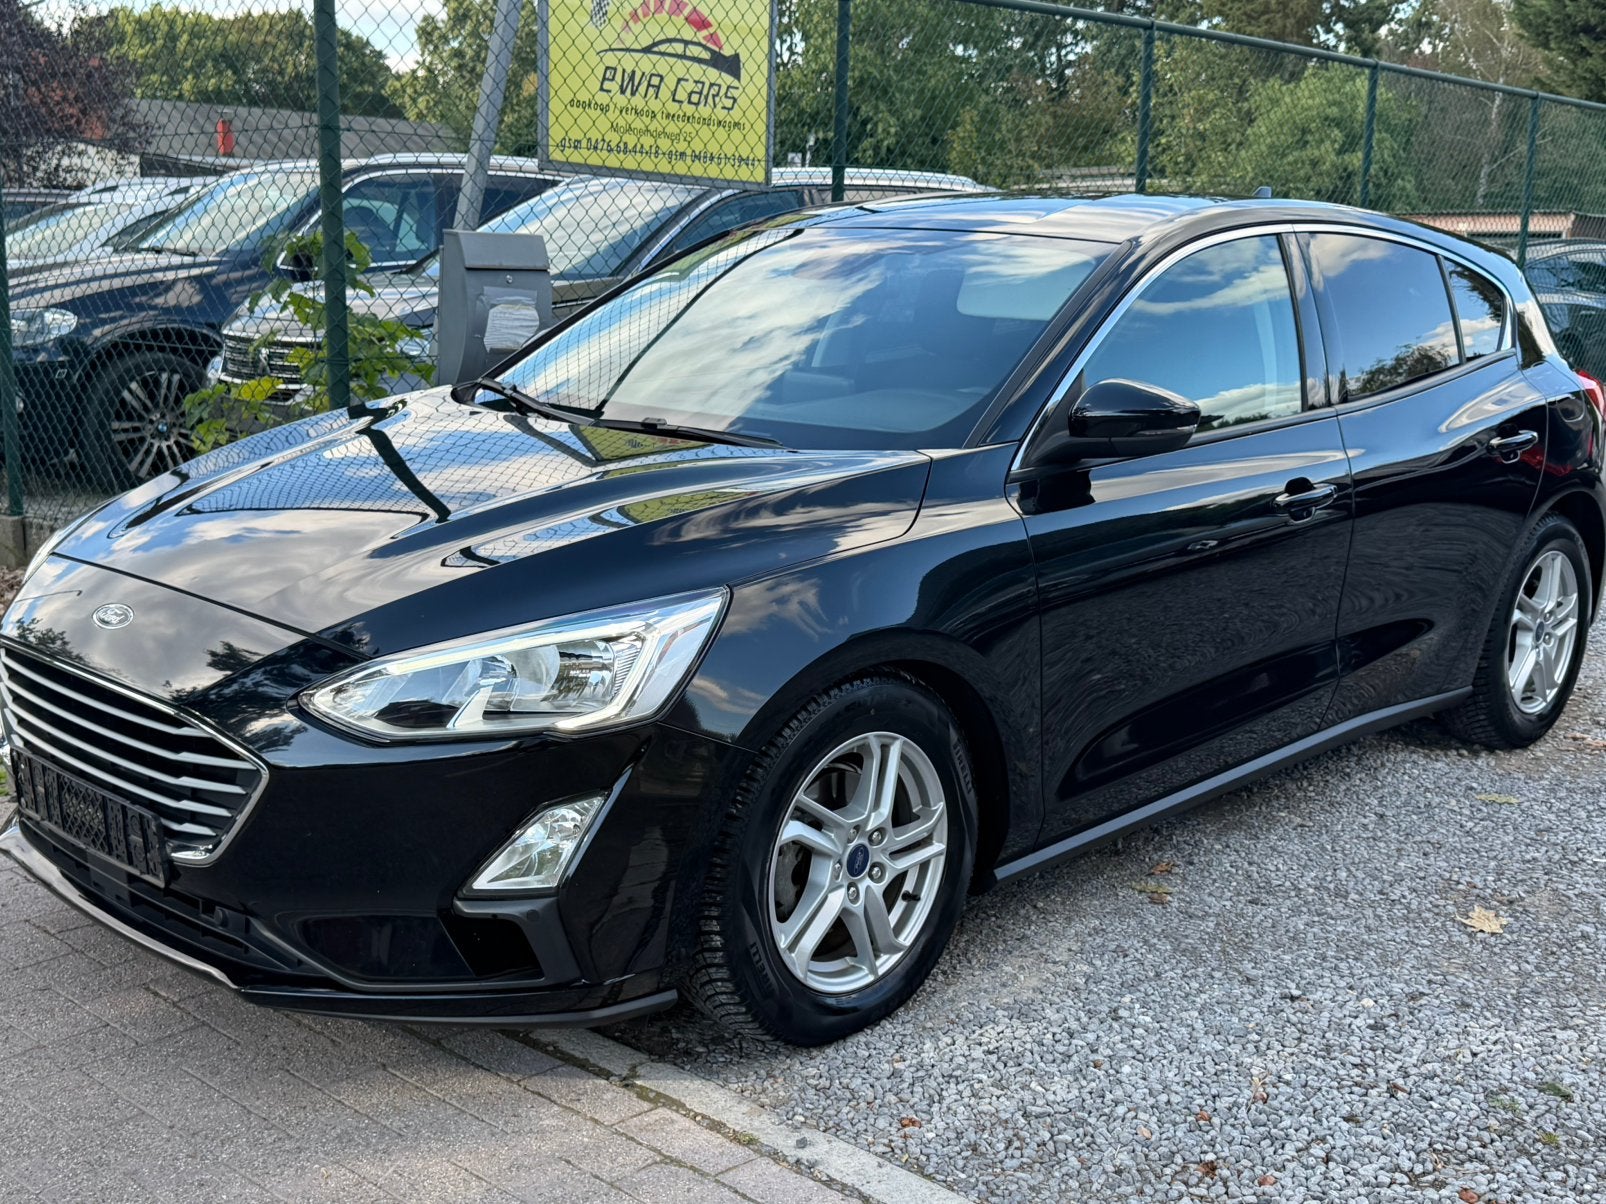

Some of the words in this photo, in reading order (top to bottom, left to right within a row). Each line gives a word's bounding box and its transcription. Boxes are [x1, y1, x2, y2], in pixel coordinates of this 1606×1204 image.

[569, 98, 610, 115] aankoop
[619, 104, 656, 121] verkoop
[683, 131, 694, 143] 25
[560, 137, 582, 153] gsm
[667, 149, 687, 164] gsm
